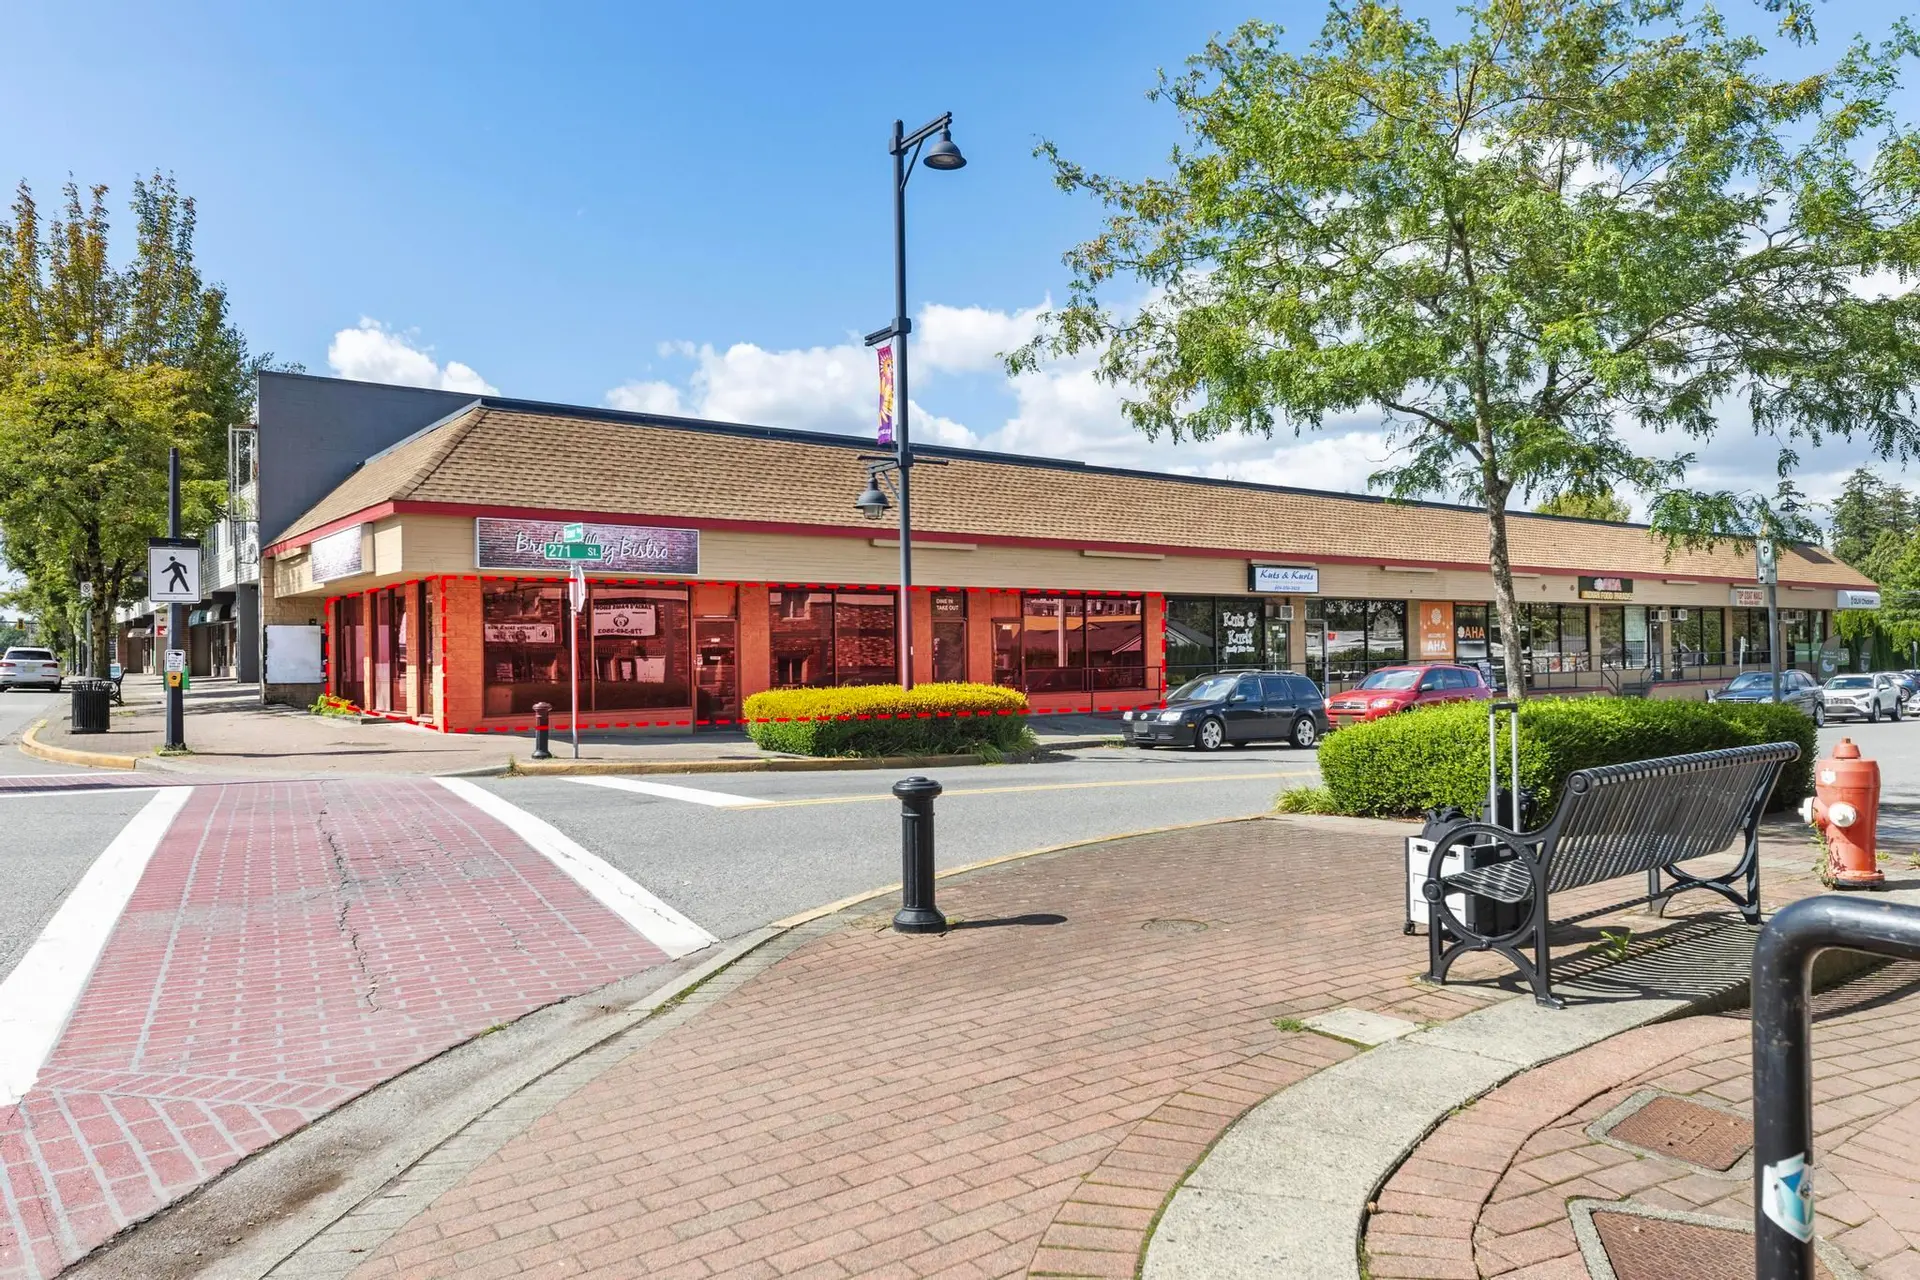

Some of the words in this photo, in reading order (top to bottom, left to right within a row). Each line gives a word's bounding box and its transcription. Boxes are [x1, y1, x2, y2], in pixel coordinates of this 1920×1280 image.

[548, 544, 571, 557] 271
[619, 536, 668, 558] Bistro
[1763, 546, 1769, 557] P
[1260, 569, 1280, 579] Kuts
[1281, 571, 1289, 580] &
[1291, 570, 1314, 581] Kurls
[1223, 611, 1245, 627] Kuts
[1247, 611, 1257, 627] &
[1227, 628, 1253, 645] Kurls
[1464, 626, 1485, 639] AHA
[1427, 639, 1447, 651] AHA
